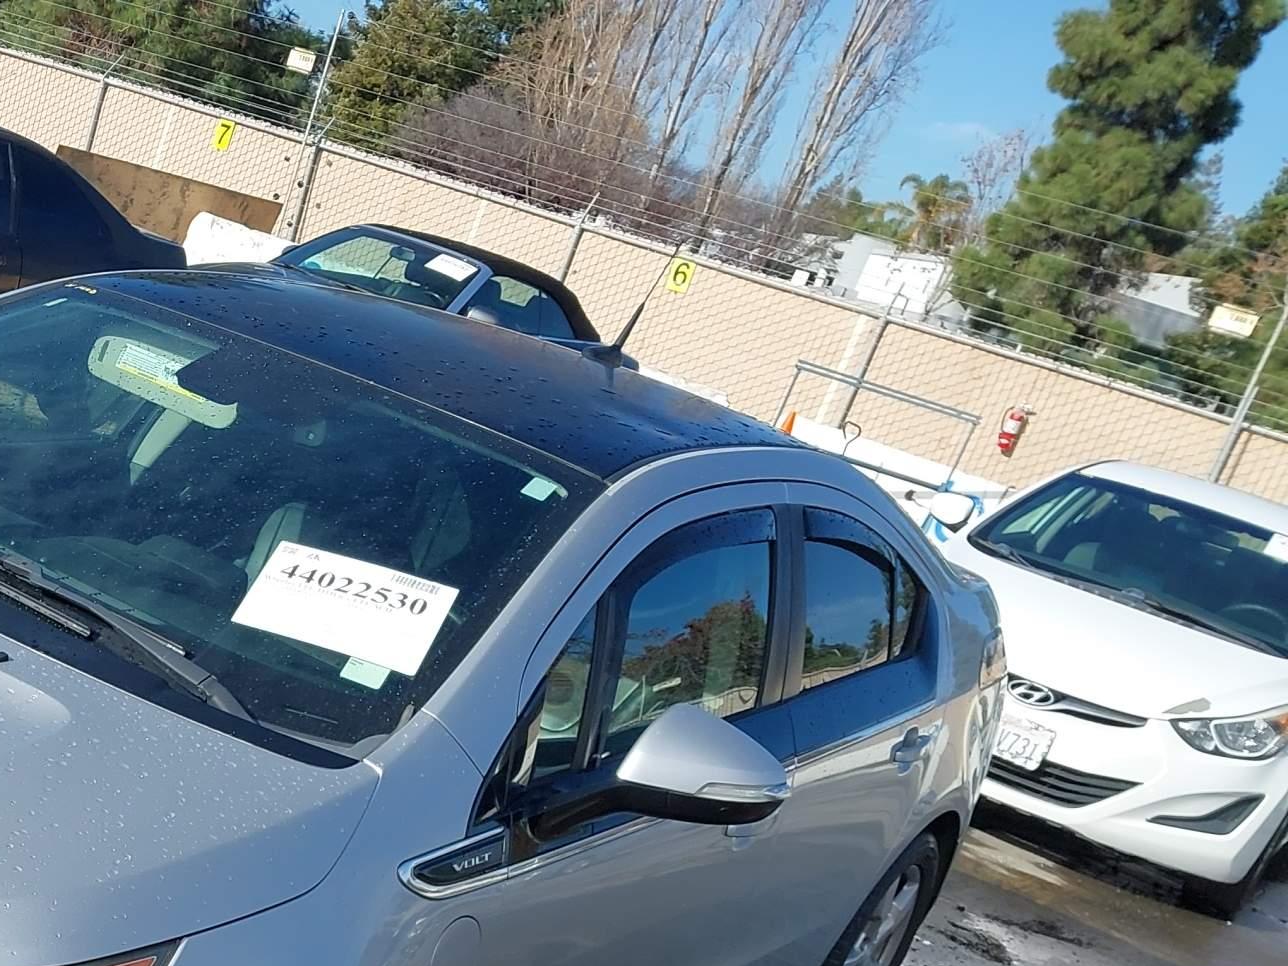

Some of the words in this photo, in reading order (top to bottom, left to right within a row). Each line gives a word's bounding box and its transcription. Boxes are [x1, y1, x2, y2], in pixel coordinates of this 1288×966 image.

[218, 123, 231, 144] 7
[672, 262, 690, 286] 6
[280, 564, 428, 615] 44022530
[453, 853, 492, 872] VOLT
